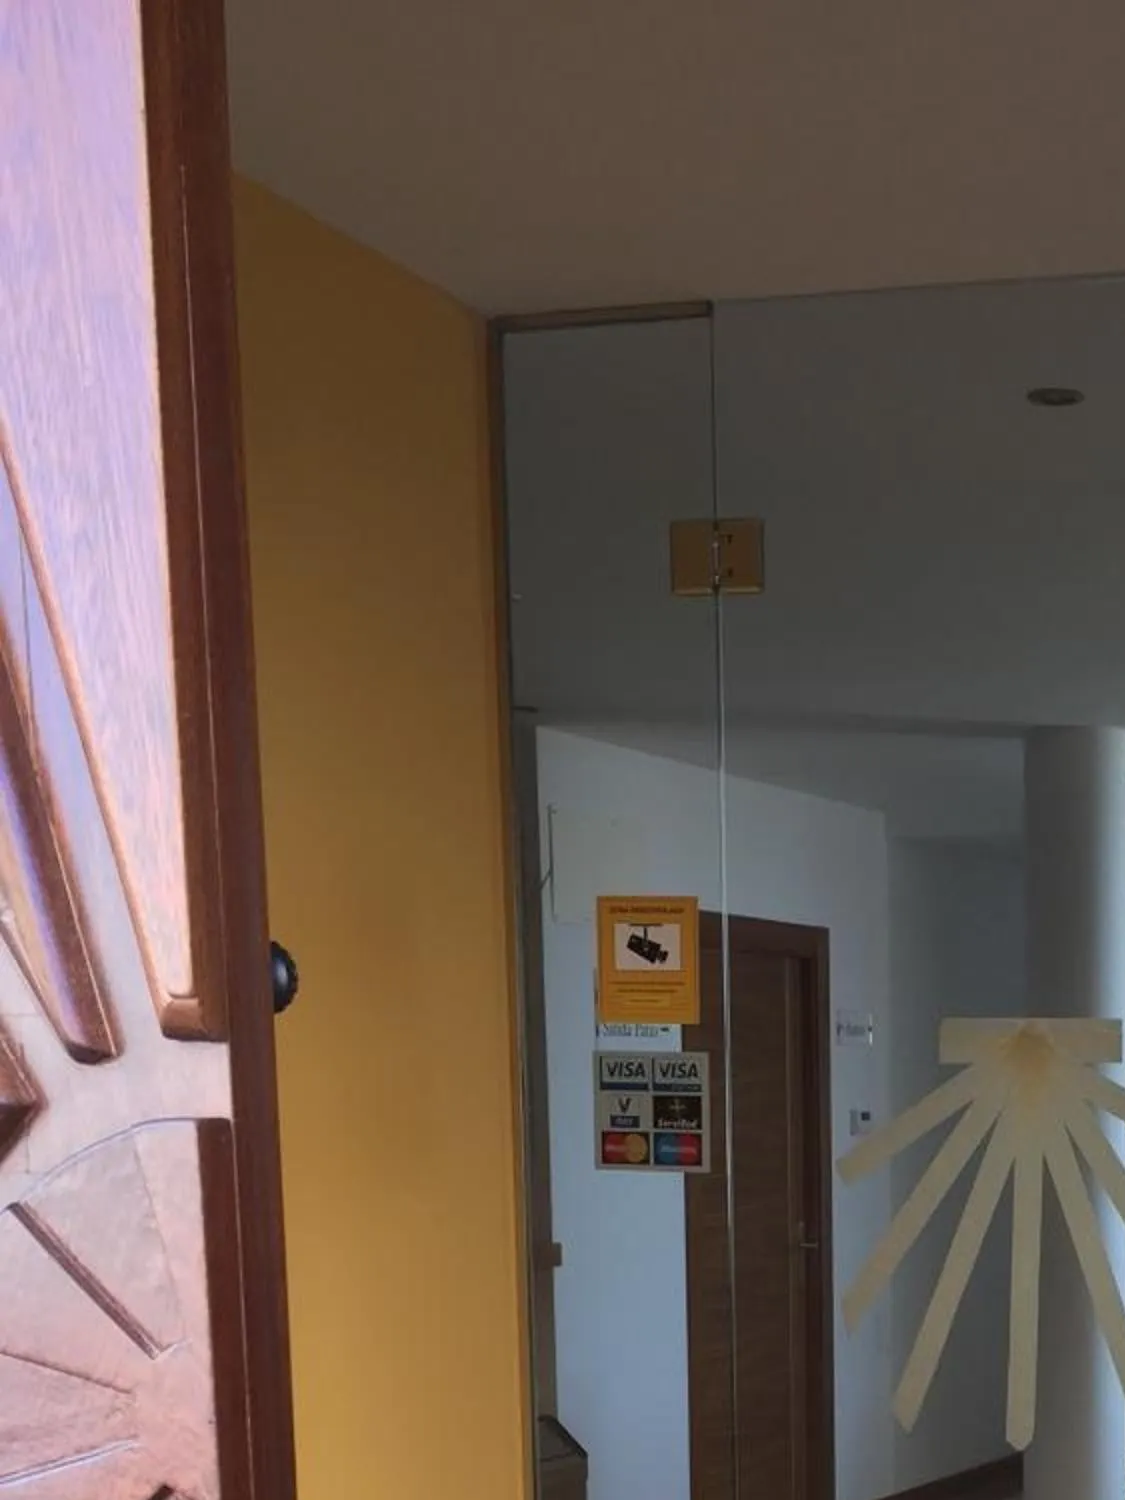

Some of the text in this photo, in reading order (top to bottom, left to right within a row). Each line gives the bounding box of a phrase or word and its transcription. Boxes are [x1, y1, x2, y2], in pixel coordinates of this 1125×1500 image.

[606, 1061, 646, 1078] VISA
[659, 1062, 699, 1079] VISA
[617, 1097, 632, 1114] V
